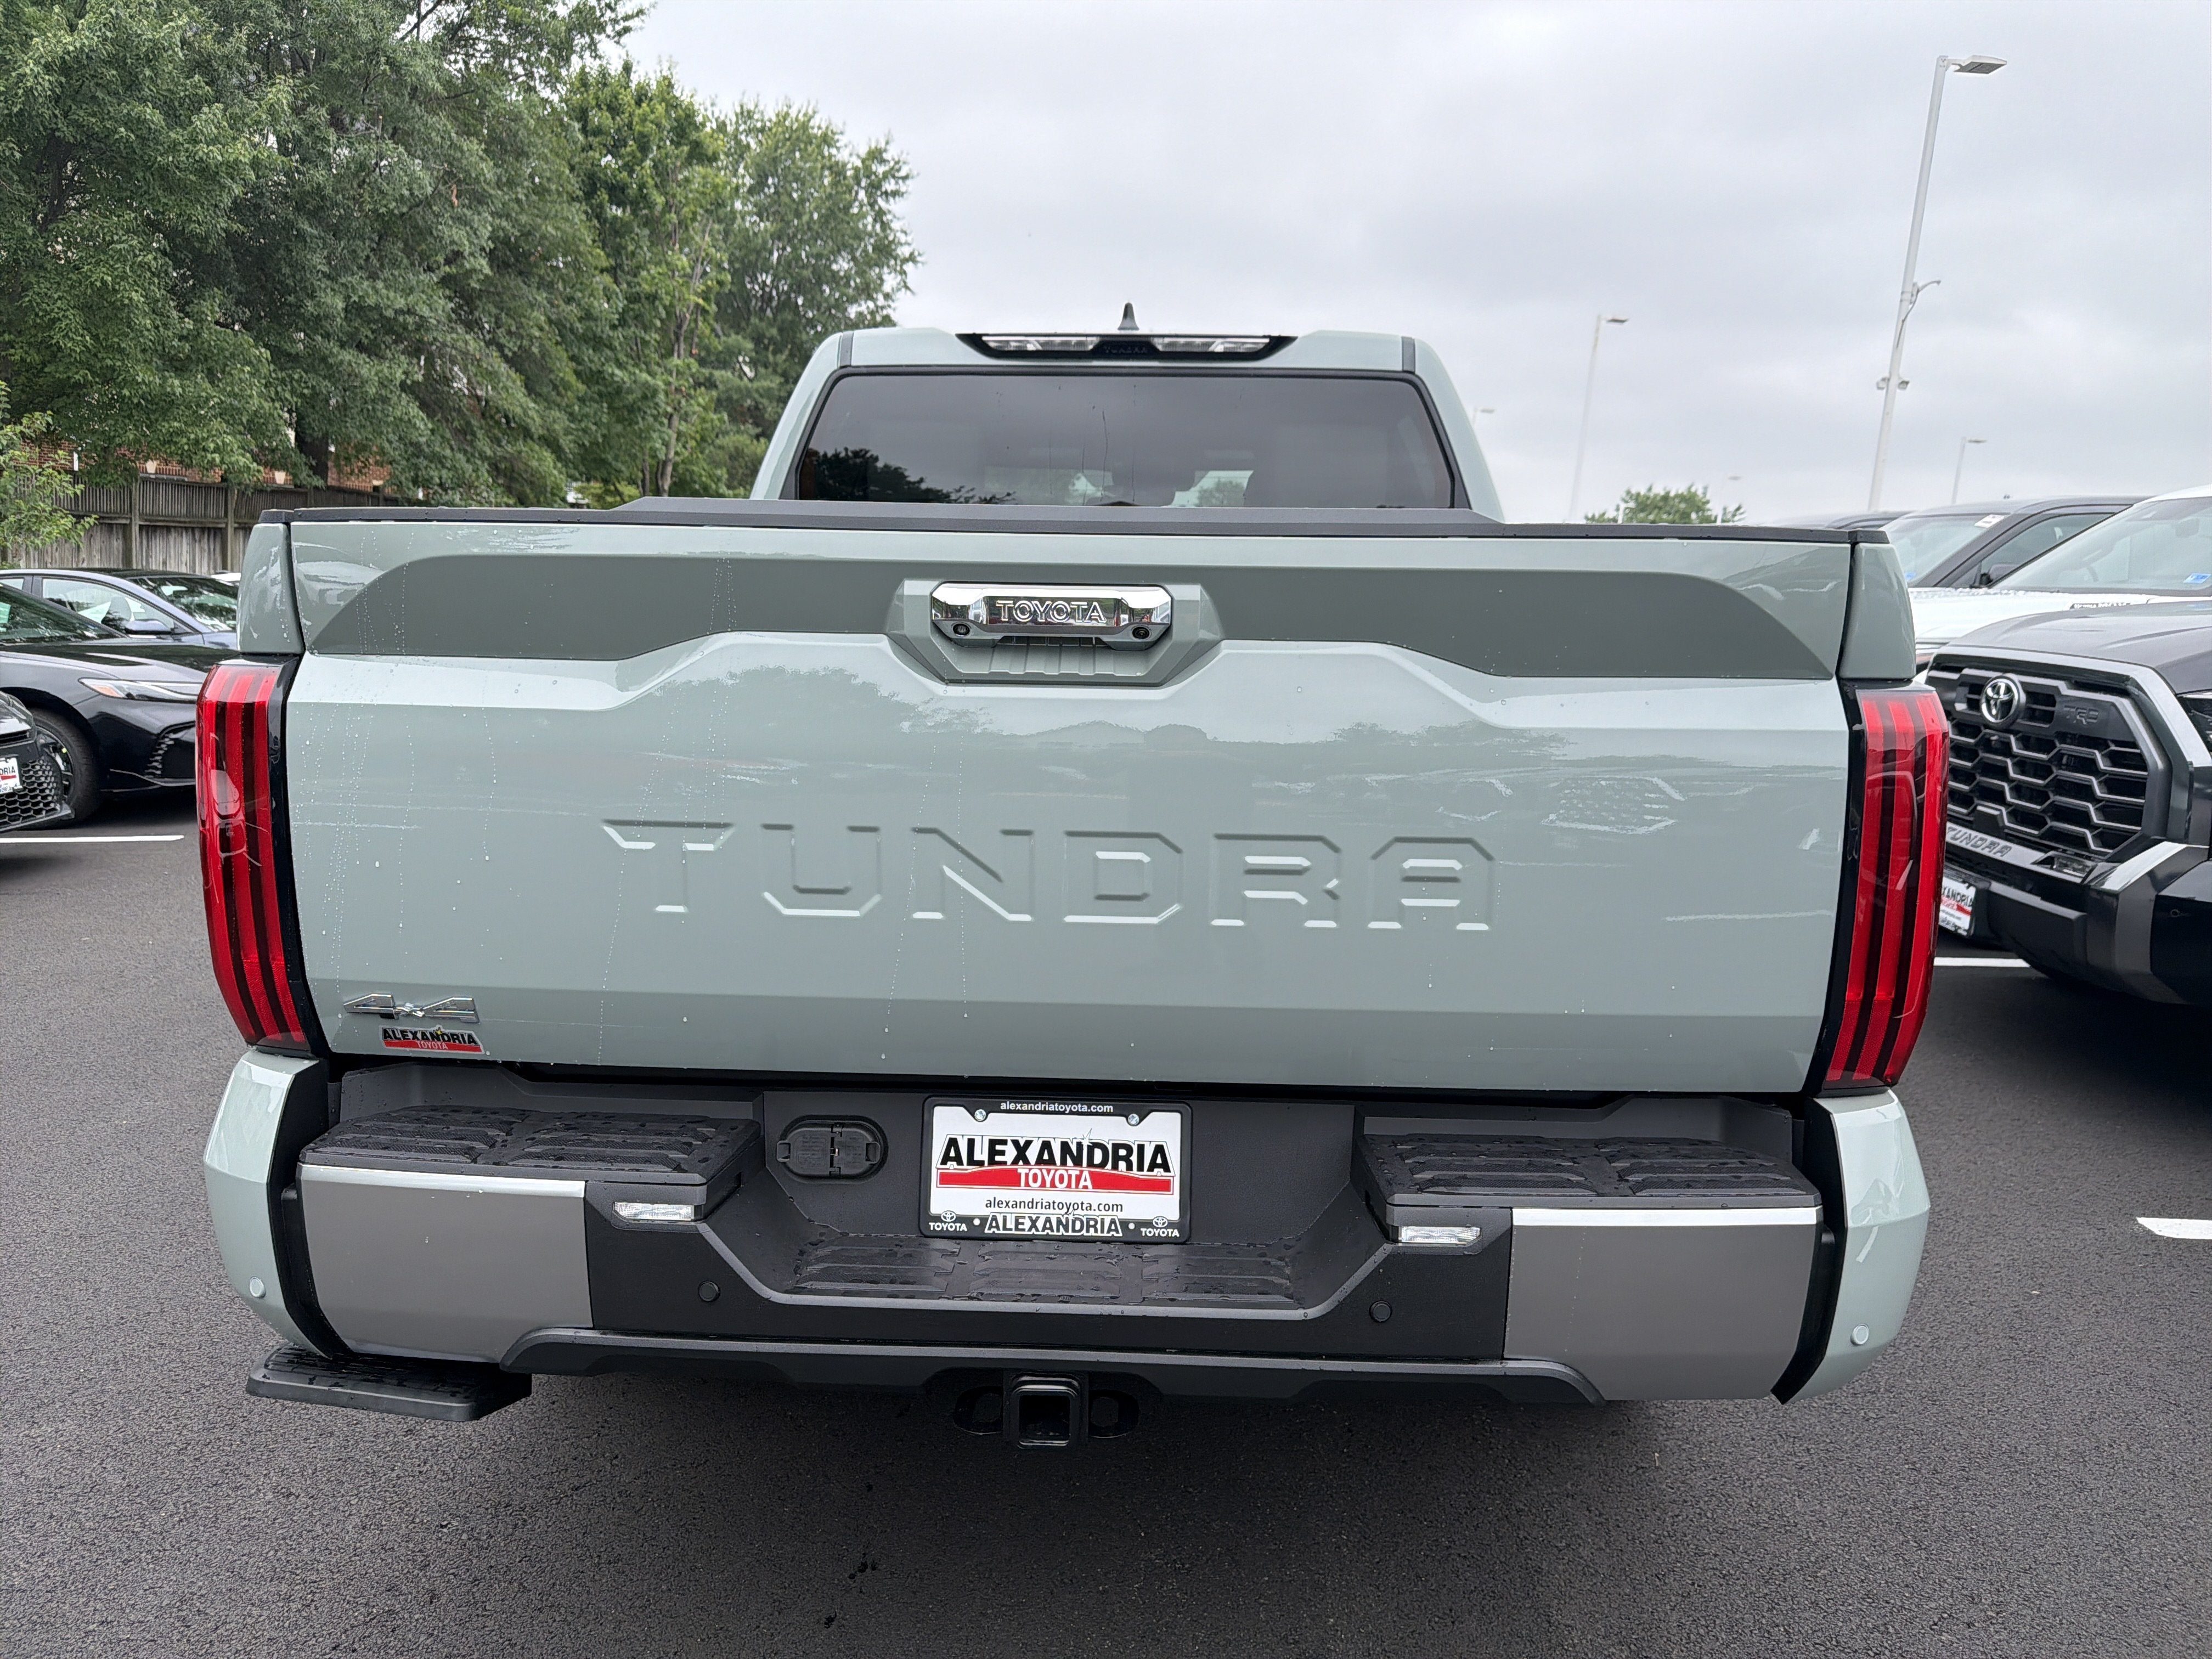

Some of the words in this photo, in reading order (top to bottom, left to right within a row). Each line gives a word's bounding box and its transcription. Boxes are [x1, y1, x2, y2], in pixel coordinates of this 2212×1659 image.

[996, 600, 1107, 624] TOYOTA
[602, 819, 1495, 931] TUNDRA
[383, 1028, 478, 1045] ALEXANDRIA
[416, 1040, 448, 1050] TOYOTA
[1000, 1101, 1114, 1114] alexandriatoyota.com
[939, 1137, 1172, 1173] ALEXANDRIA
[1017, 1168, 1093, 1190] TOYOTA
[985, 1197, 1124, 1213] alexandriatoyota.com
[929, 1221, 968, 1232] TOYOTA
[984, 1212, 1123, 1237] ALEXANDRIA
[1140, 1227, 1180, 1238] TOYOTA
